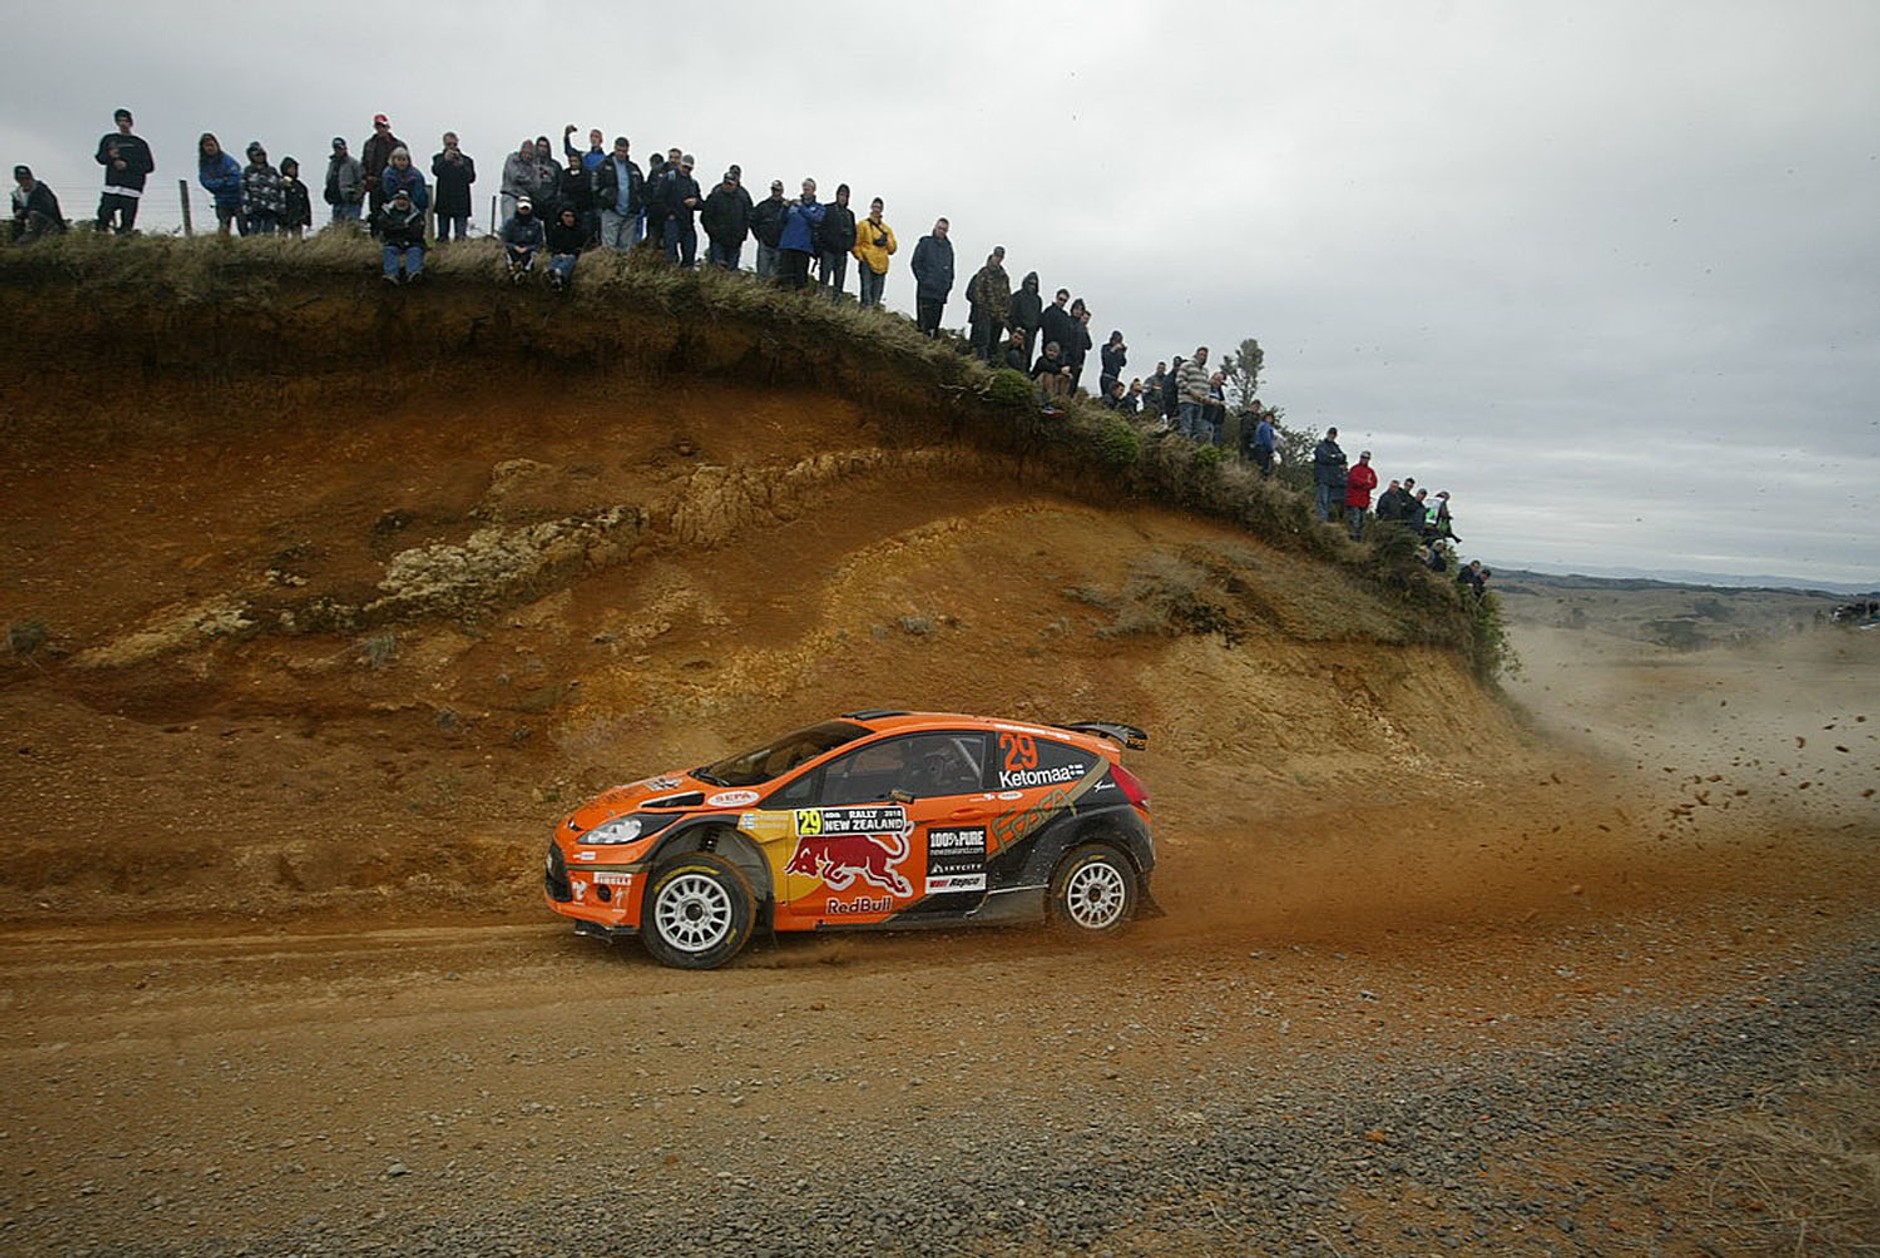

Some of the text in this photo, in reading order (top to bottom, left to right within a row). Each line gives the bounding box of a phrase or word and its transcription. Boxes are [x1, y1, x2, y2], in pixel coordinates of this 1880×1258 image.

[1000, 734, 1039, 771] 29
[999, 765, 1071, 788] Ketomaa
[848, 810, 878, 819] RALLY
[799, 810, 821, 835] 29
[825, 818, 904, 832] NEW ZEALAND
[958, 831, 984, 846] PURE
[949, 877, 980, 887] Repco
